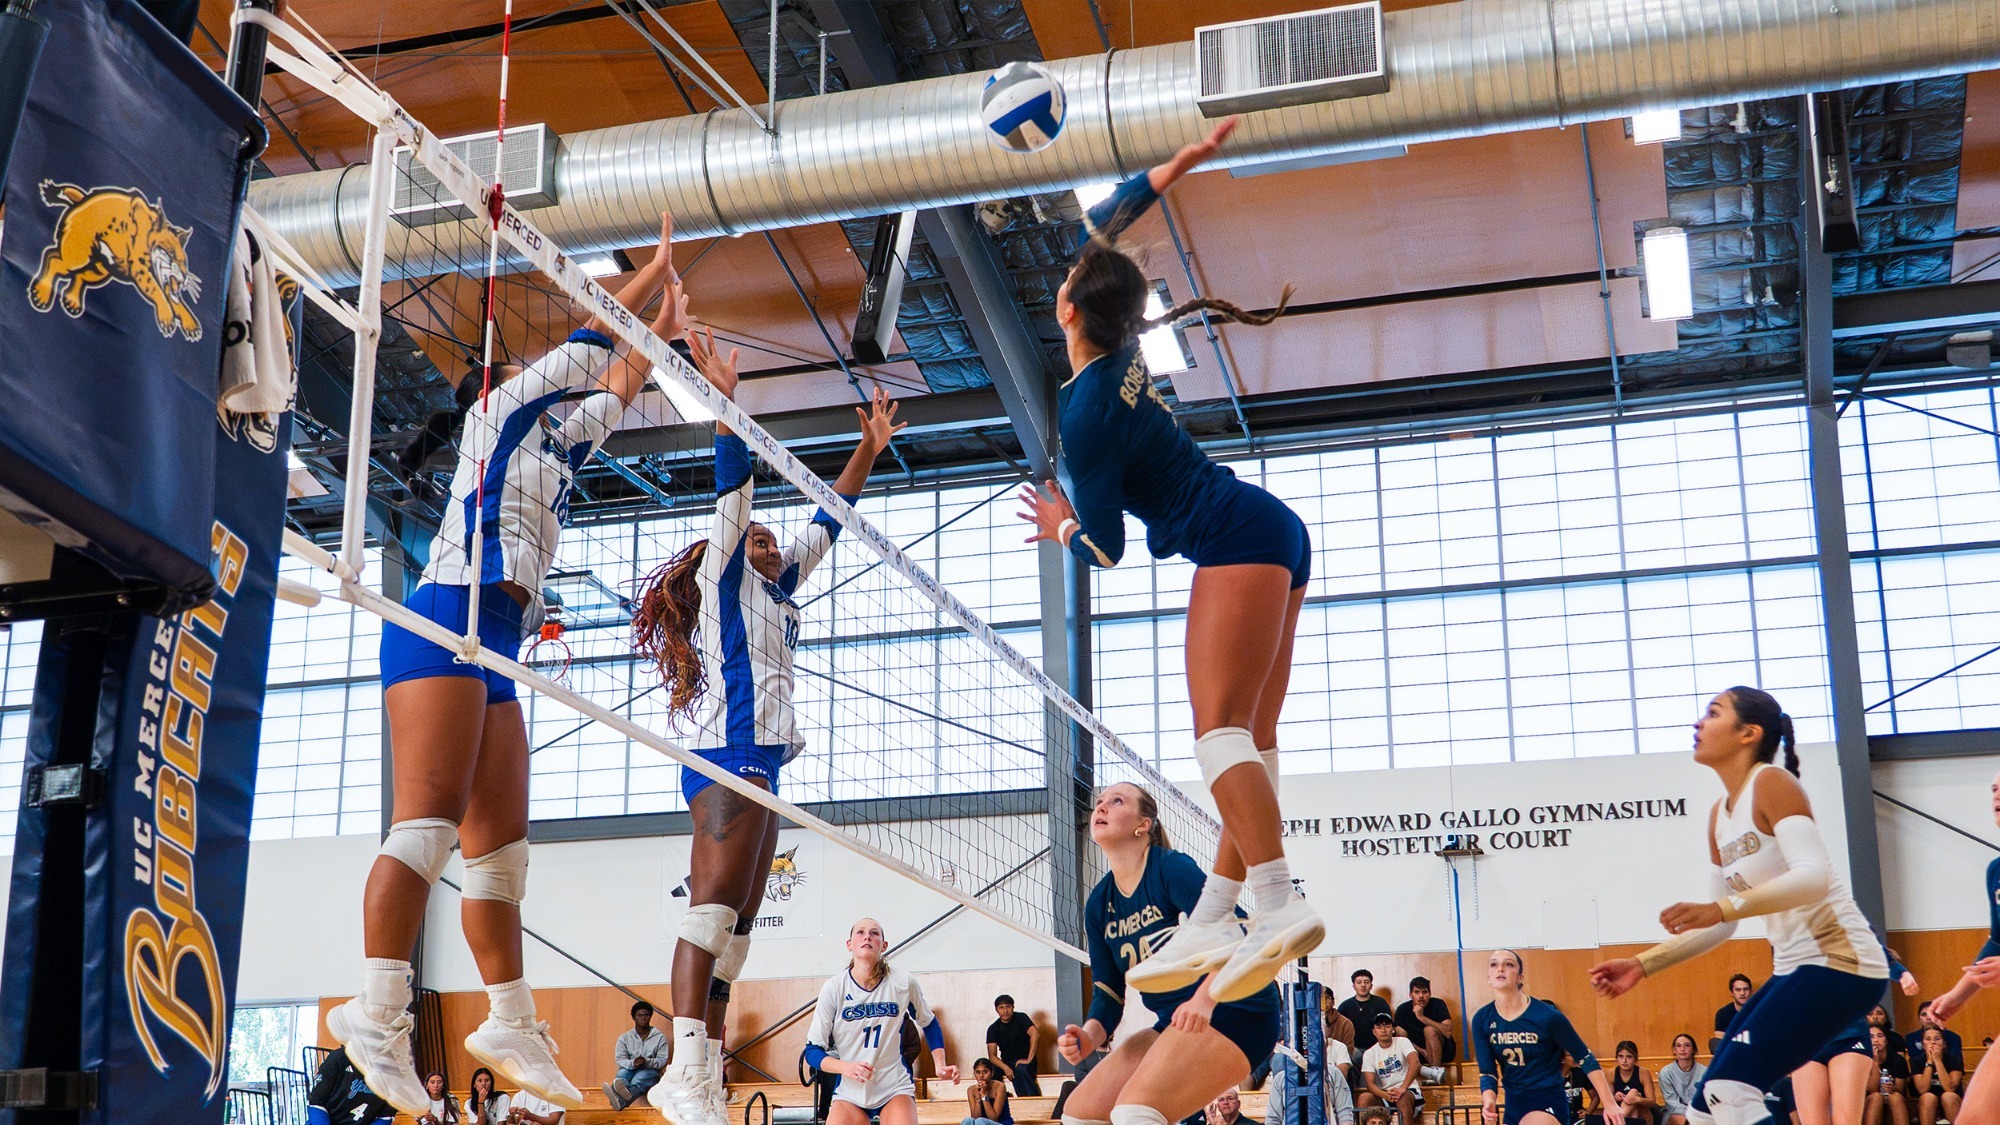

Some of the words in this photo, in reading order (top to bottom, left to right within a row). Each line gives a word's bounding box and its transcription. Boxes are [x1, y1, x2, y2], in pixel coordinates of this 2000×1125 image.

[595, 291, 633, 330] MERCED
[664, 351, 677, 370] UC
[677, 364, 710, 397] MERCED
[749, 423, 778, 455] MERCED
[135, 613, 179, 799] MERCE
[124, 519, 249, 1107] BOBCATS
[1280, 818, 1322, 838] EPH
[1330, 812, 1432, 836] EDWARD
[1440, 807, 1521, 829] GALLO
[1529, 797, 1688, 825] GYMNASIUM
[134, 816, 152, 885] UC
[1489, 828, 1572, 850] COURT
[754, 915, 784, 928] FITTER
[841, 1001, 900, 1021] CSUSB
[862, 1024, 882, 1049] 11
[1497, 1031, 1539, 1045] MERCED
[1502, 1047, 1526, 1067] 21
[349, 1102, 369, 1122] 4
